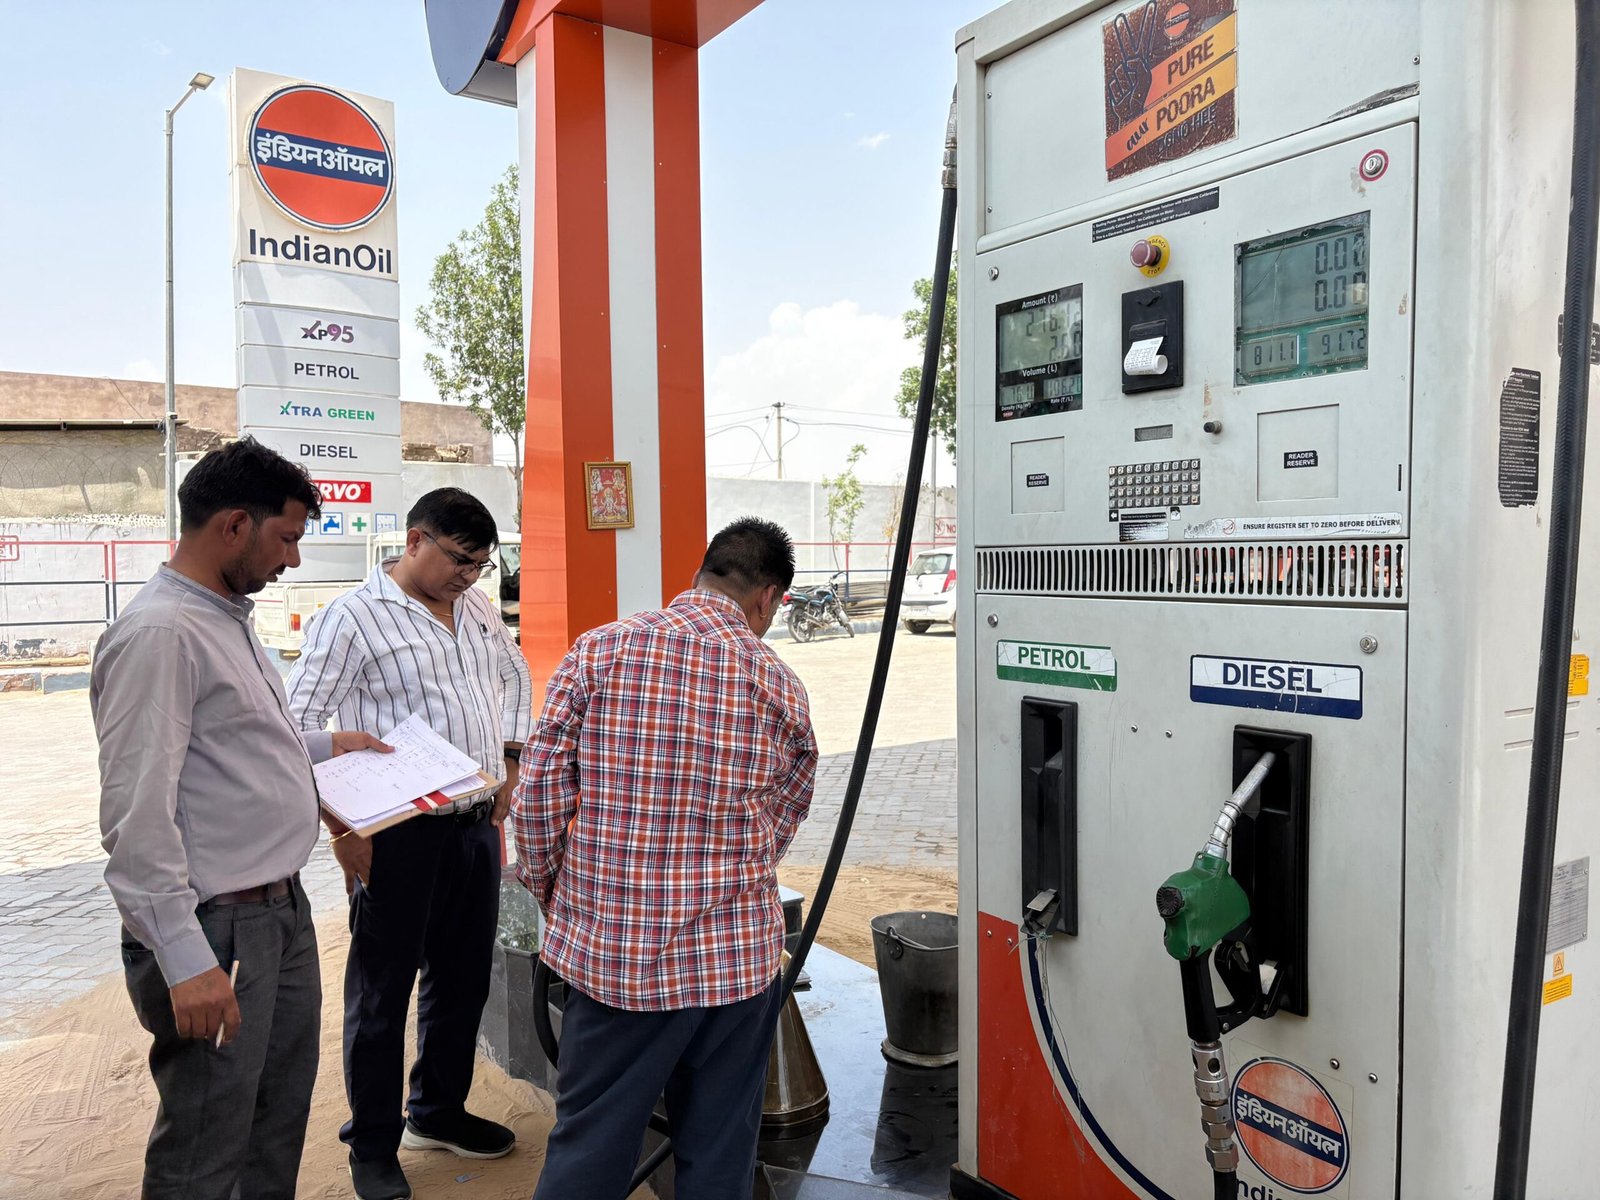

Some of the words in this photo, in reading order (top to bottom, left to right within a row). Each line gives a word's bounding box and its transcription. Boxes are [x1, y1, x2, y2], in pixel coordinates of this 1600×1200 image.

[1167, 34, 1215, 85] PURE
[1156, 76, 1216, 131] POORA
[256, 132, 386, 178] इंडियनऑयल
[249, 228, 392, 274] IndianOil
[1022, 296, 1047, 309] Amount
[1315, 271, 1367, 312] 0.00
[1321, 328, 1367, 355] 91.72
[294, 362, 360, 380] PETROL
[1022, 366, 1046, 377] Volume
[279, 401, 323, 418] XTRA
[327, 407, 376, 421] GREEN
[299, 443, 358, 459] DIESEL
[1286, 459, 1316, 467] RESERVE
[1288, 452, 1314, 460] READER
[1297, 521, 1309, 529] SET
[1339, 520, 1365, 528] BEFORE
[1366, 519, 1401, 527] DELIVERY
[1017, 646, 1091, 671] PETROL
[1222, 662, 1323, 693] DIESEL
[1236, 1094, 1342, 1158] इंडियनऑयल
